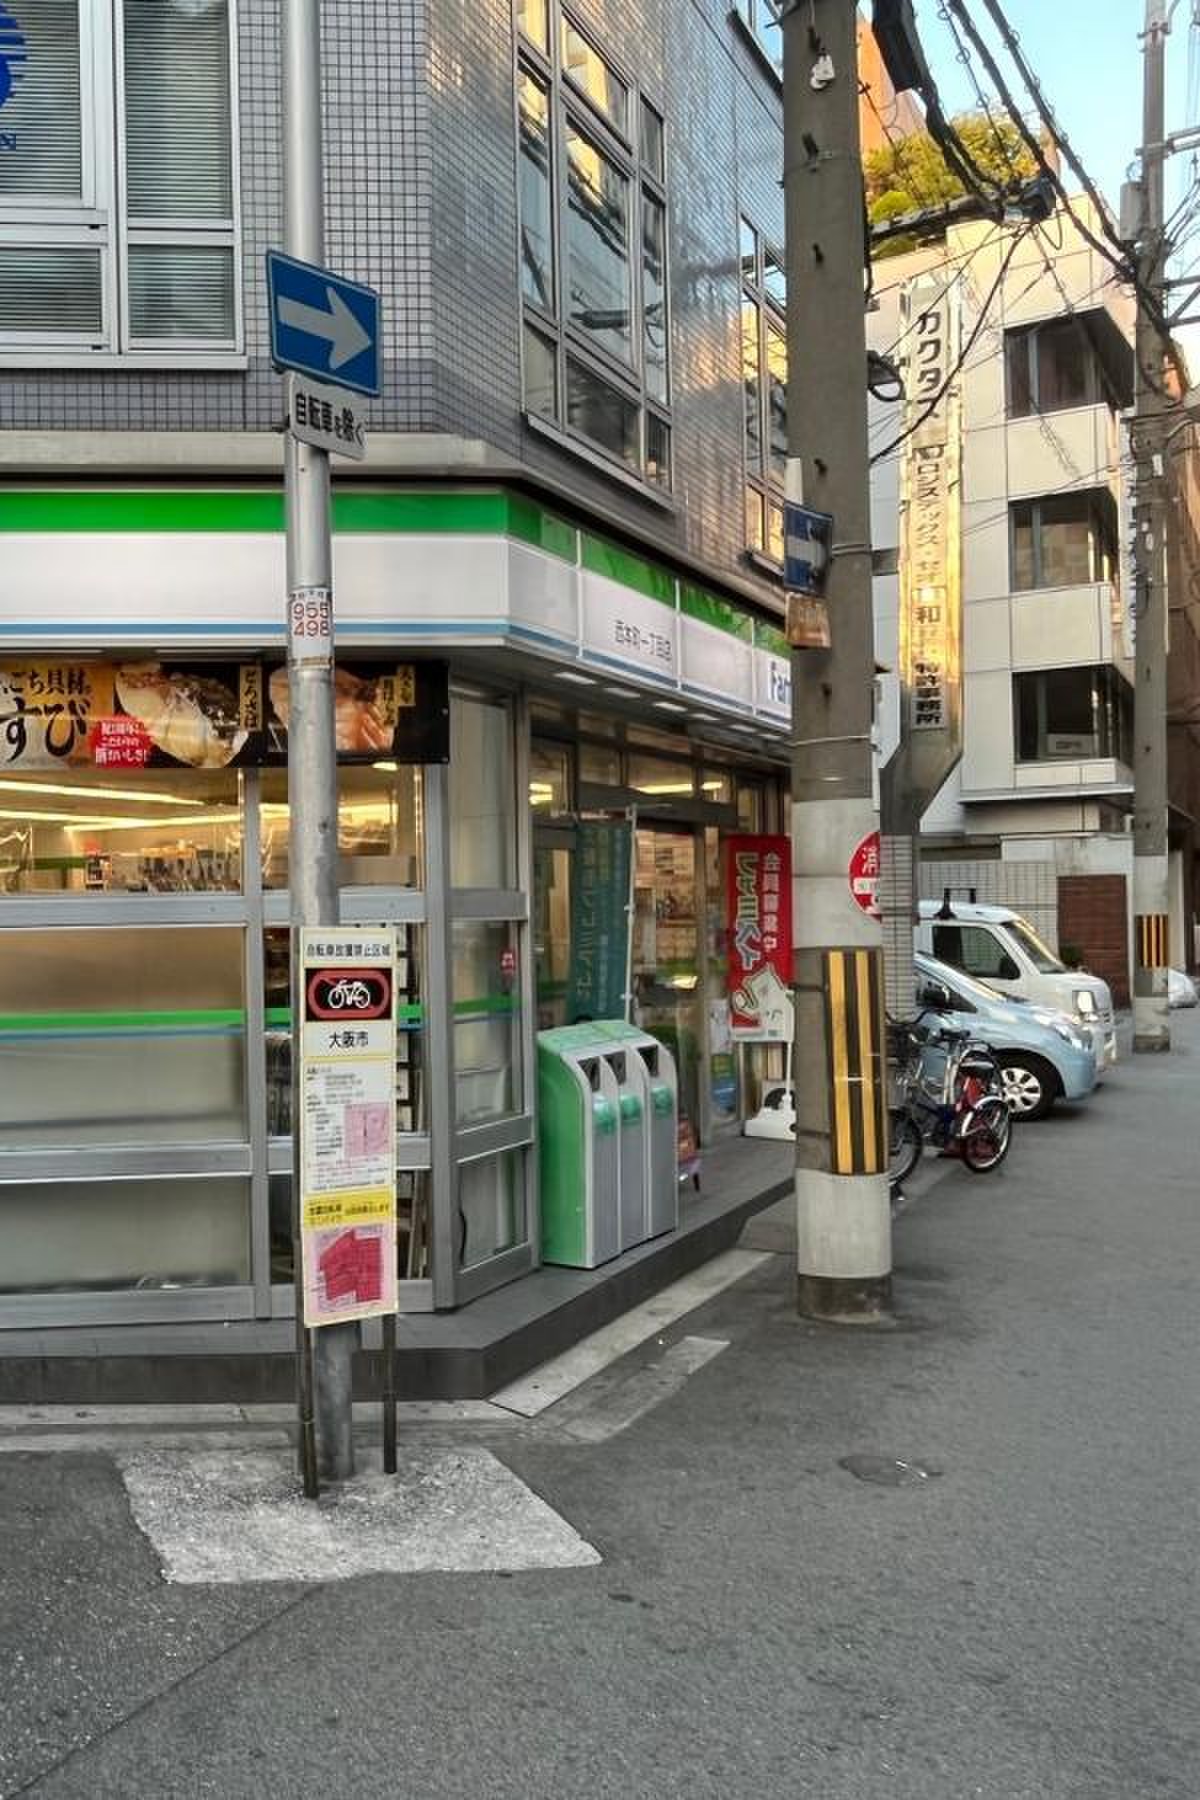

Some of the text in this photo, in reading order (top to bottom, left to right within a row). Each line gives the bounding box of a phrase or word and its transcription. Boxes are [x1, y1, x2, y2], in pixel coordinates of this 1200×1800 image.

[294, 601, 328, 620] 955
[294, 620, 329, 638] 498
[306, 943, 391, 957] 自転車放置禁止区域
[329, 1031, 368, 1048] 大阪市
